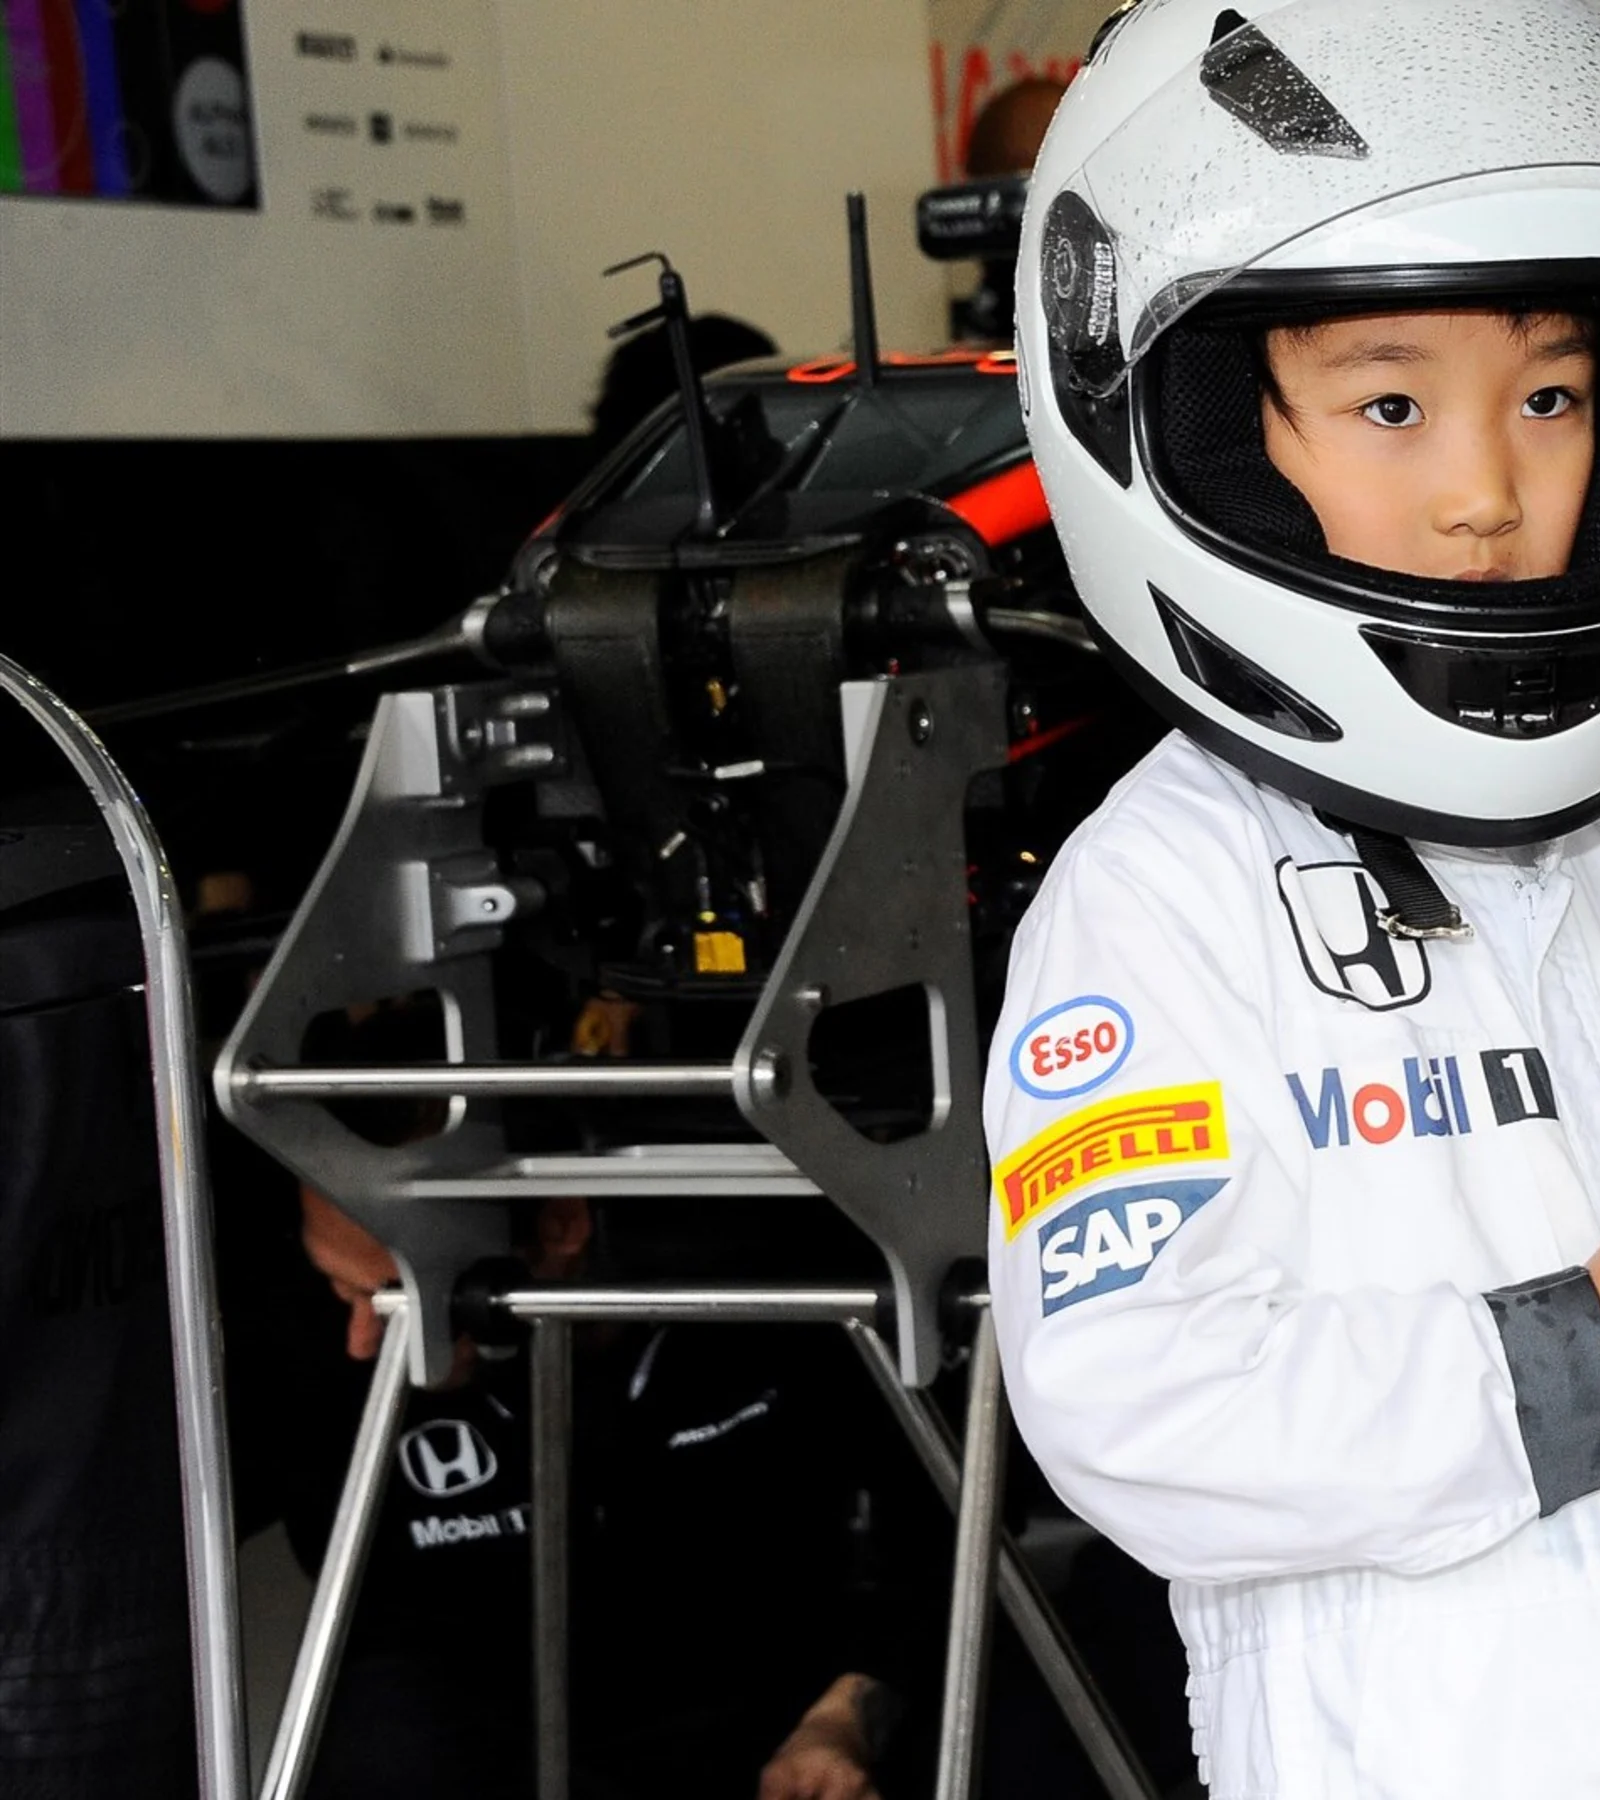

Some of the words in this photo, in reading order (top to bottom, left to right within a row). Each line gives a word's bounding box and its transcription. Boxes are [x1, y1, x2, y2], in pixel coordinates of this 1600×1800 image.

[1030, 1021, 1117, 1077] Esso
[1285, 1056, 1472, 1150] Mobil
[1501, 1052, 1540, 1115] 1
[1003, 1100, 1212, 1226] PIRELLI
[1042, 1197, 1183, 1299] SAP
[410, 1514, 500, 1549] Mobil
[508, 1507, 526, 1533] 1
